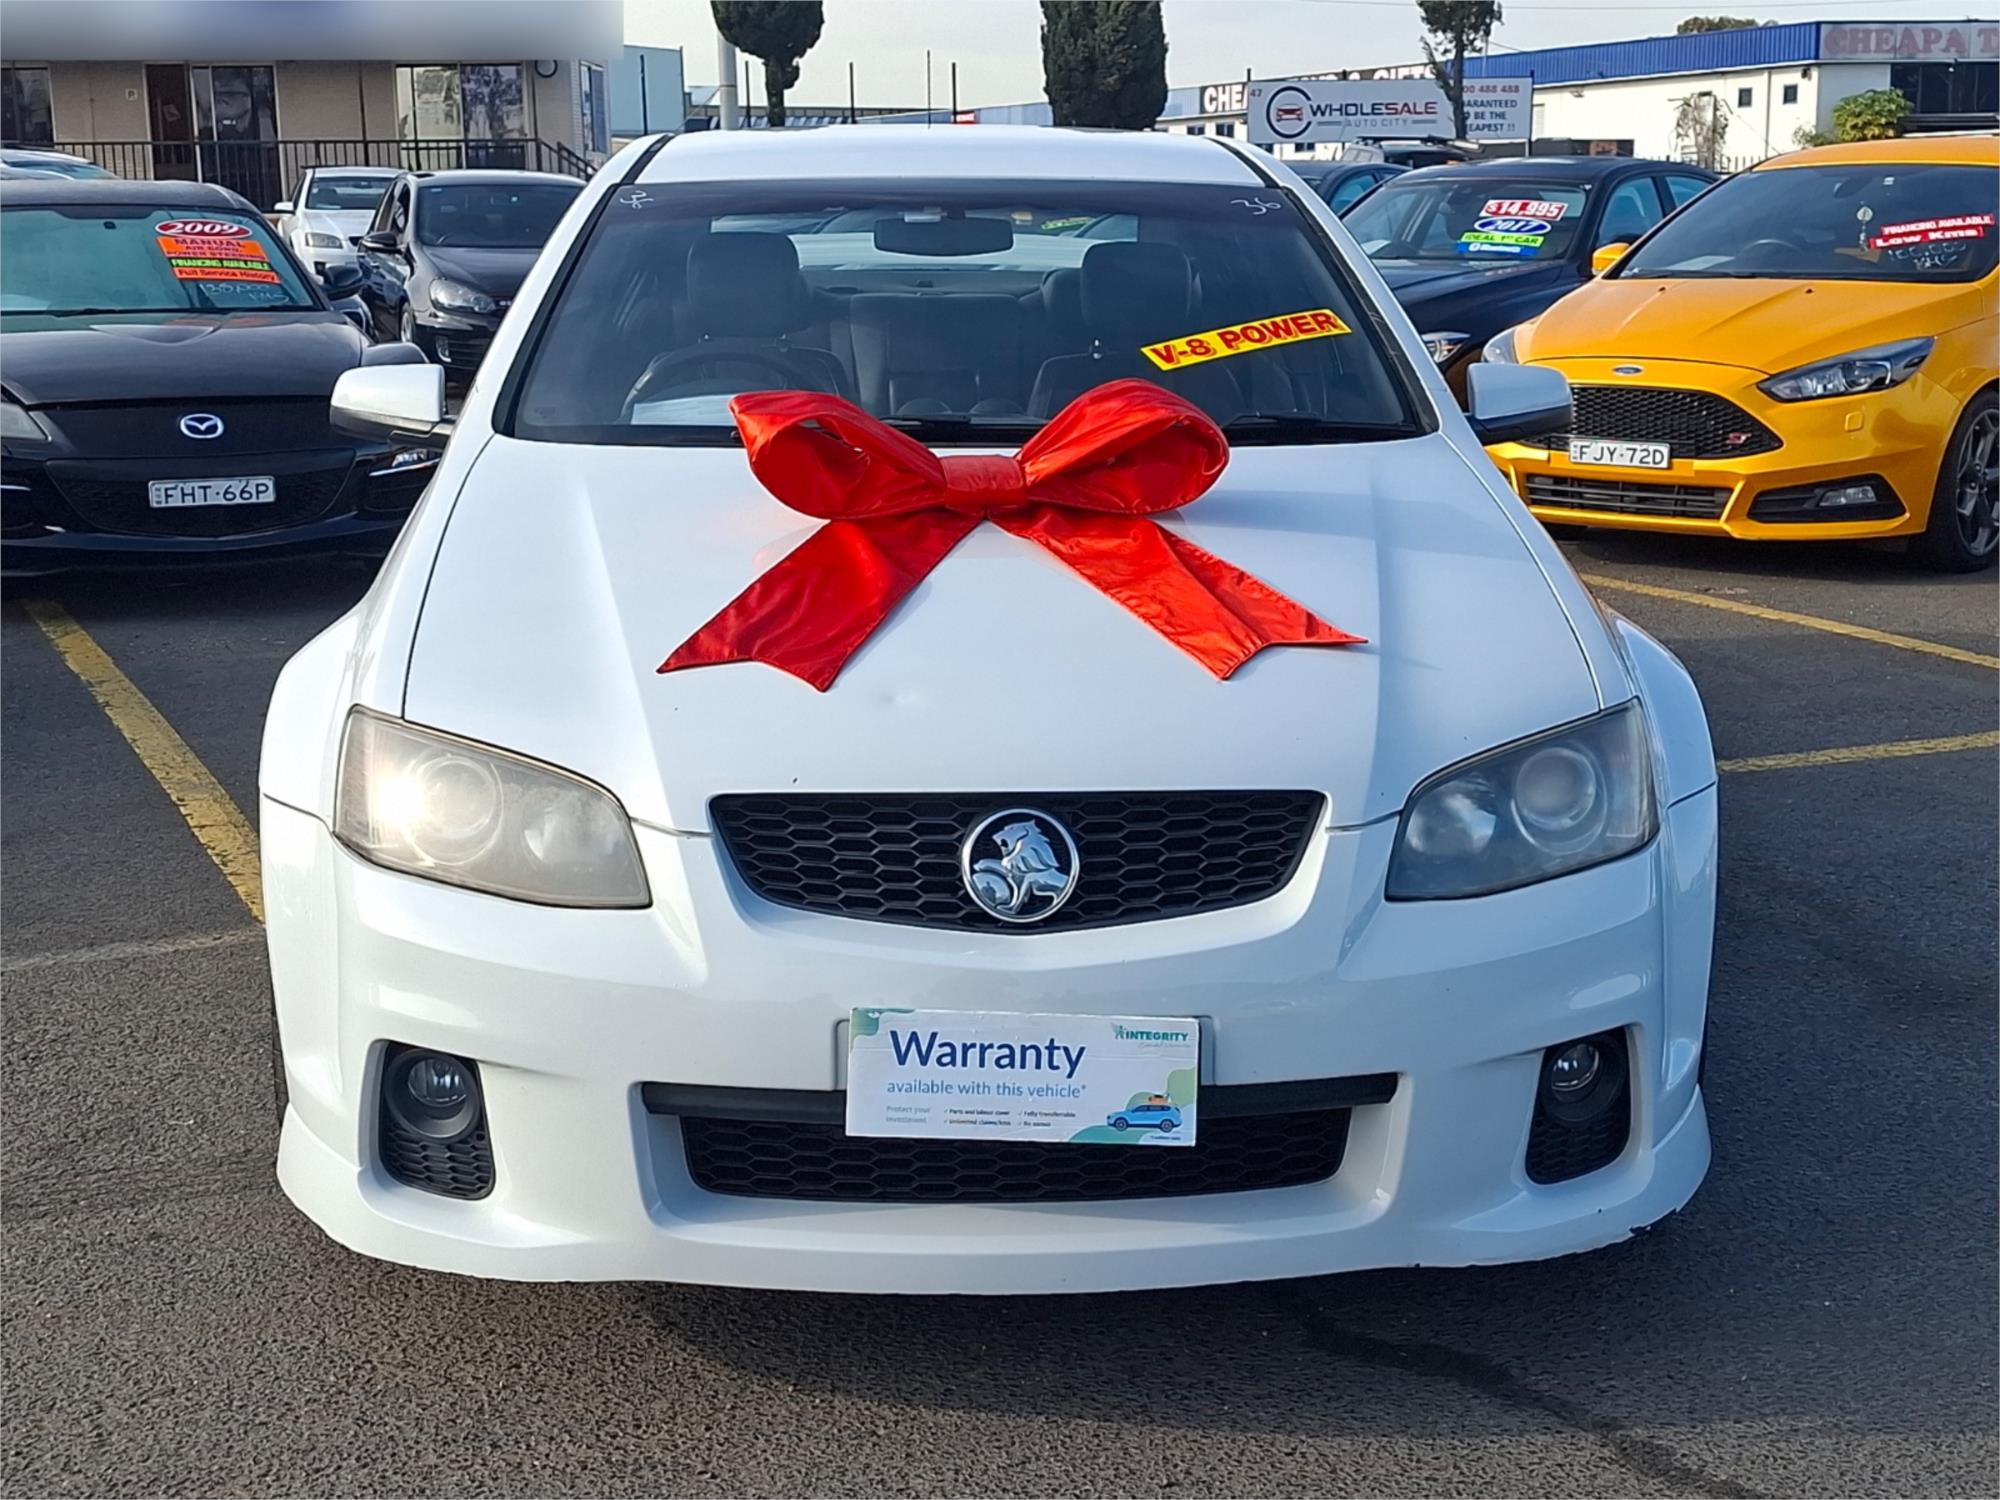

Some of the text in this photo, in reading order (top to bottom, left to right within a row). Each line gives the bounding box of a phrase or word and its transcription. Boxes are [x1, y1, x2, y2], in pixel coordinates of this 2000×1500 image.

[1825, 27, 1967, 56] CHEAPA
[1310, 102, 1438, 117] WHOLESALE
[1474, 111, 1486, 120] BE
[1489, 111, 1506, 120] THE
[1346, 118, 1408, 127] AUTO CITY
[1485, 201, 1560, 218] $14,995
[168, 222, 239, 234] 2009
[1489, 220, 1541, 232] 2017
[175, 239, 246, 248] MANUAL
[1515, 236, 1538, 244] CAR
[1876, 234, 1922, 247] Low
[1150, 312, 1341, 364] V-8 POWER
[1126, 1031, 1188, 1041] INTEGRITY
[890, 1030, 1086, 1079] Warranty
[887, 1079, 953, 1095] available
[958, 1080, 991, 1095] with
[996, 1081, 1023, 1096] this
